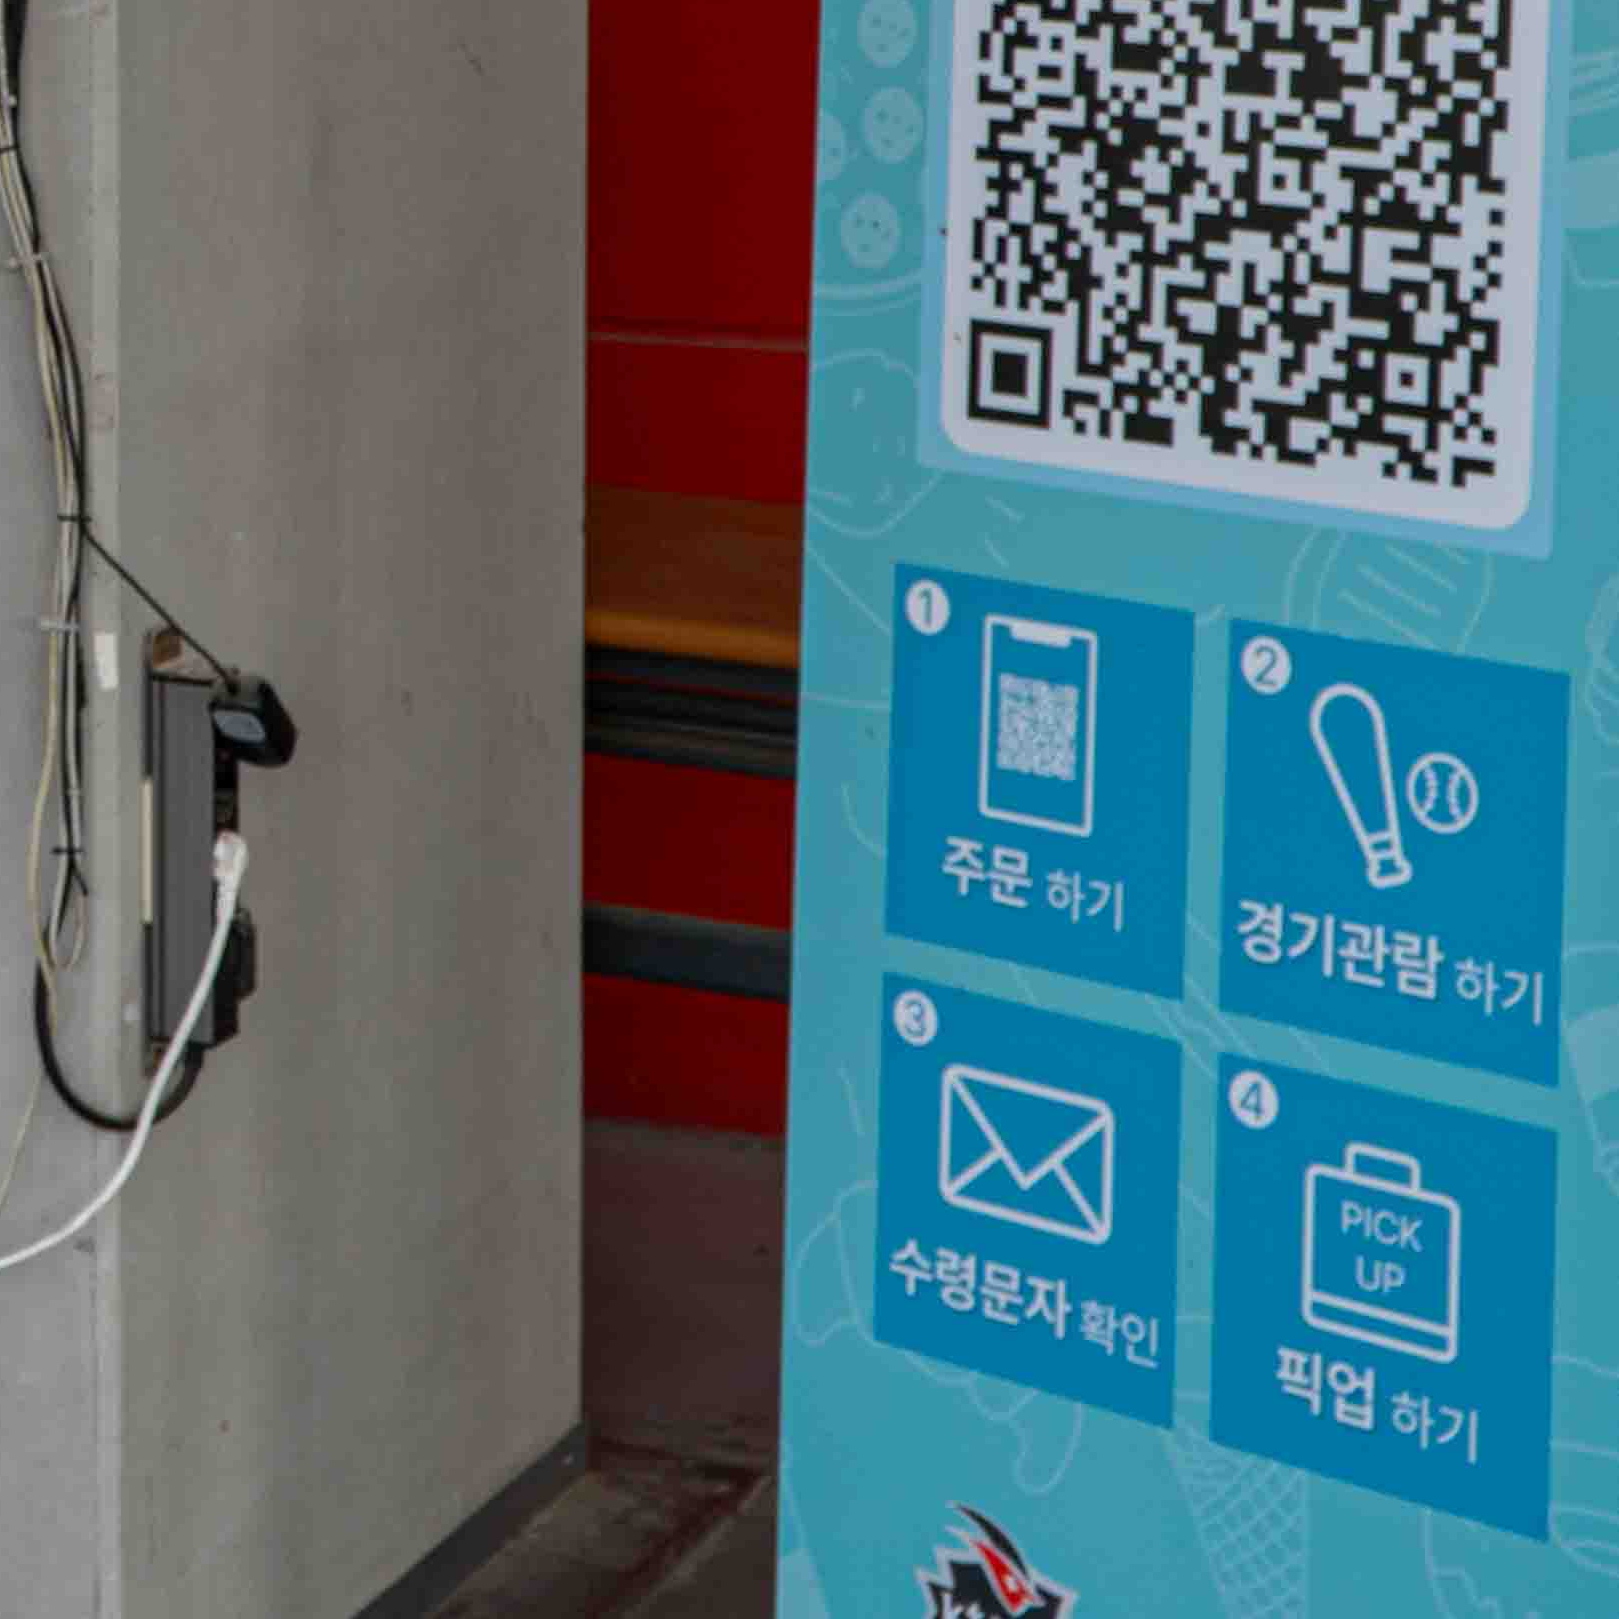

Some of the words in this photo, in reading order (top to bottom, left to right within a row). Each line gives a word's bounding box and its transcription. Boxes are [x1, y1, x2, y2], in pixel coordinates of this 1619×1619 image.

[941, 835, 1034, 908] 주문
[1046, 868, 1126, 932] 하기
[1236, 898, 1444, 1002] 경기관람
[1454, 959, 1545, 1027] 하기
[1341, 1198, 1423, 1253] PICK
[1355, 1253, 1406, 1295] UP
[888, 1238, 1070, 1339] 수령문자
[1079, 1298, 1160, 1370] 확인
[1275, 1346, 1376, 1431] 픽업
[1390, 1388, 1481, 1464] 하기
